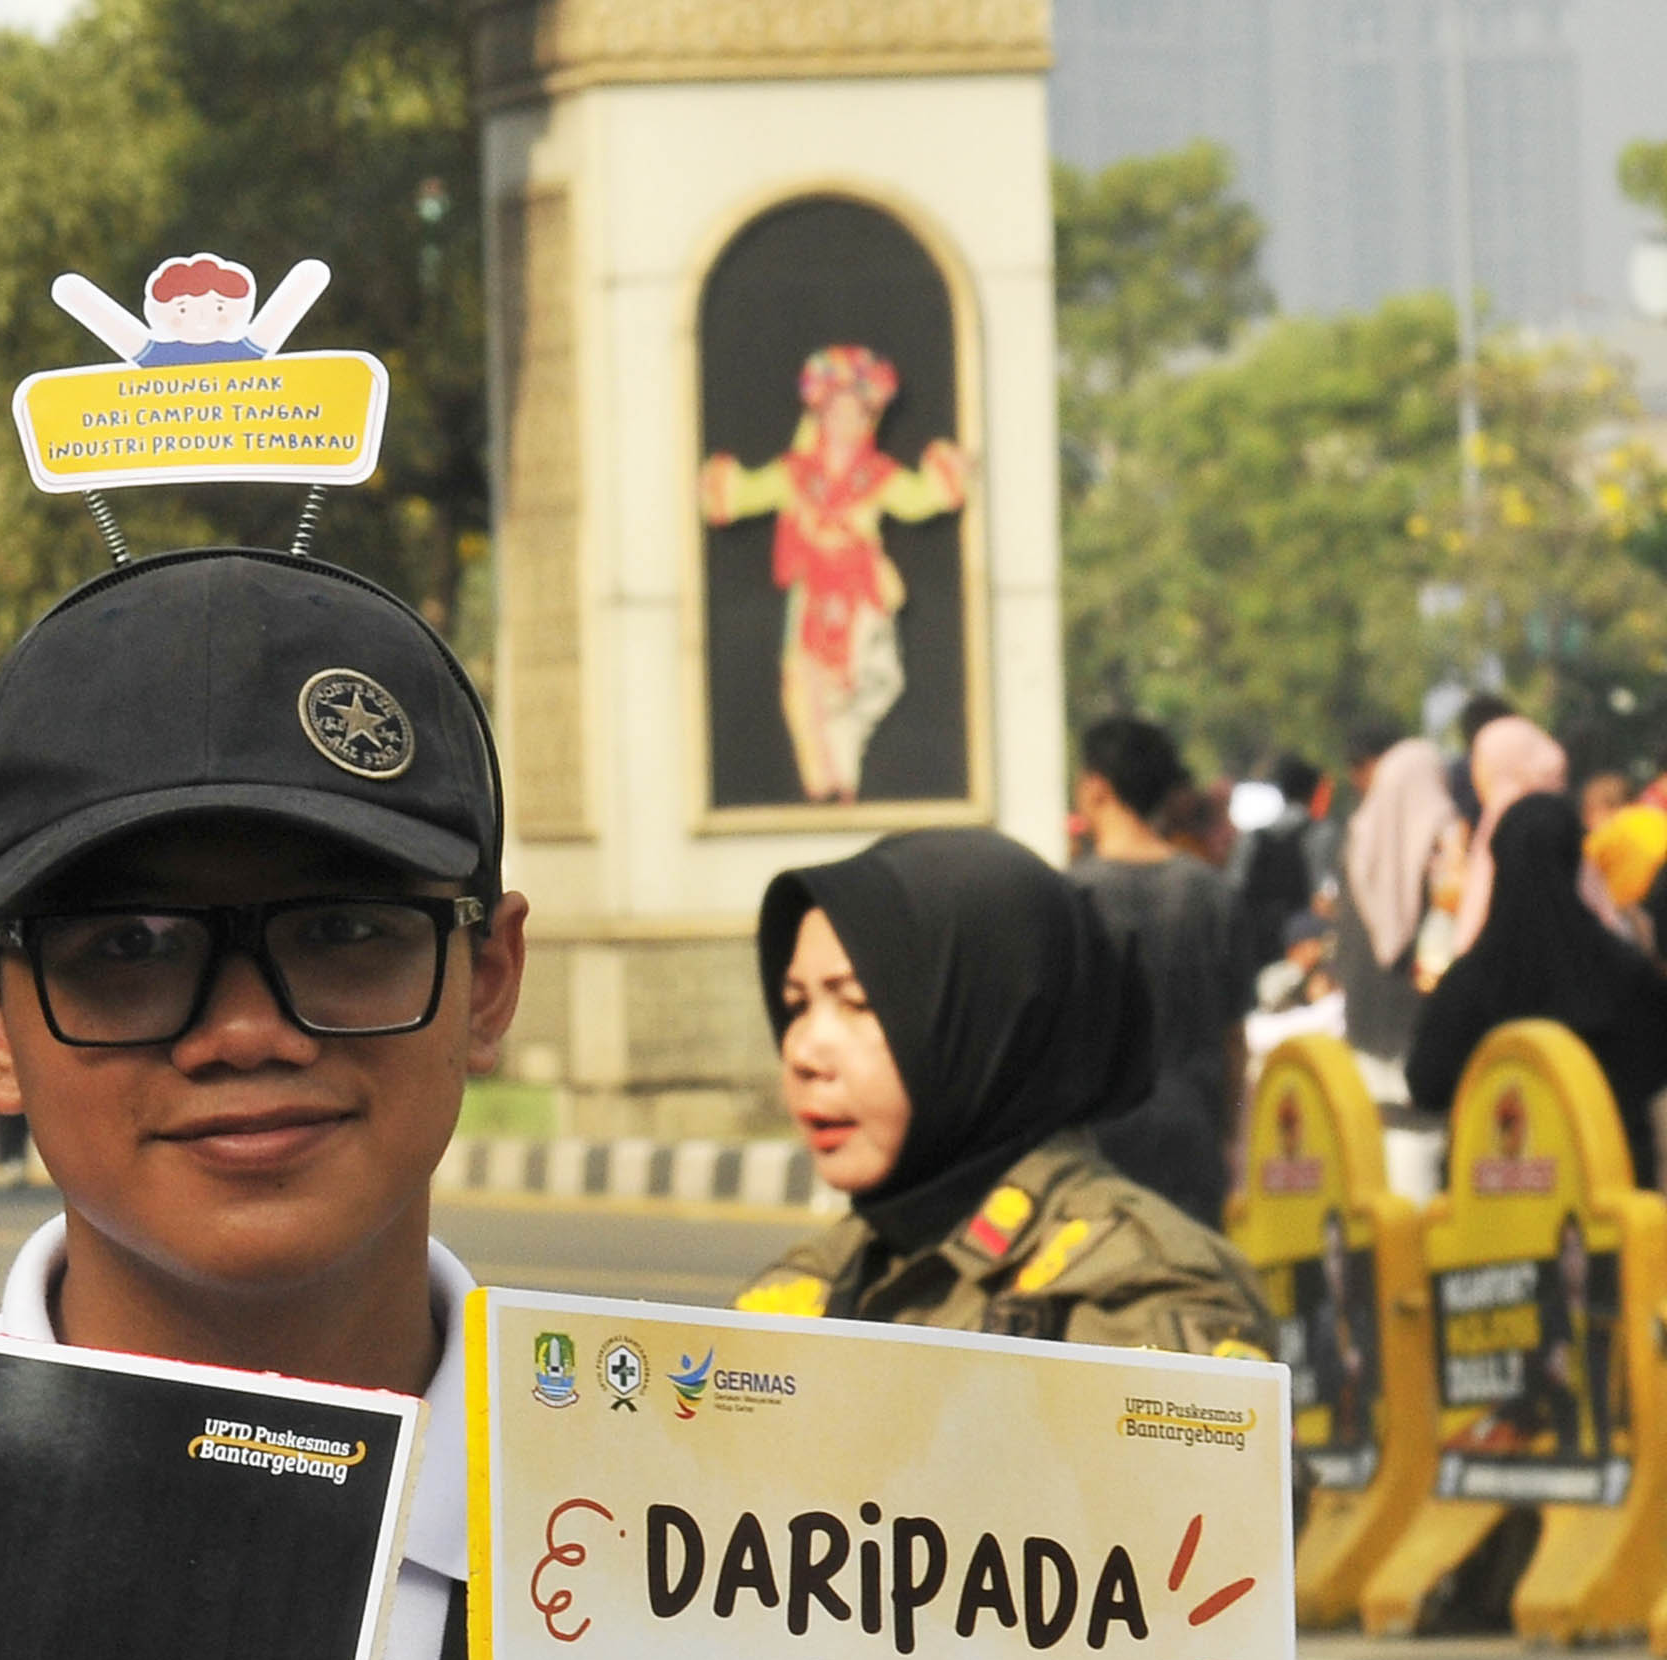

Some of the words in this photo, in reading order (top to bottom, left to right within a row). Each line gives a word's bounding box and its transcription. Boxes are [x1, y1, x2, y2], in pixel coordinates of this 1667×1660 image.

[226, 374, 283, 392] ANAK
[135, 405, 224, 425] CAMPUR
[232, 404, 322, 422] TANGAN
[151, 433, 235, 456] PRODUK
[243, 432, 357, 452] TEMBAKAU
[713, 1369, 797, 1396] GERMAS
[1125, 1397, 1164, 1416] UPTD
[1166, 1401, 1244, 1424] Puskesmas
[204, 1417, 253, 1441] UPTD
[254, 1425, 352, 1457] Puskesmas
[1125, 1418, 1246, 1452] Bantargebang
[199, 1439, 350, 1486] Bantargebang
